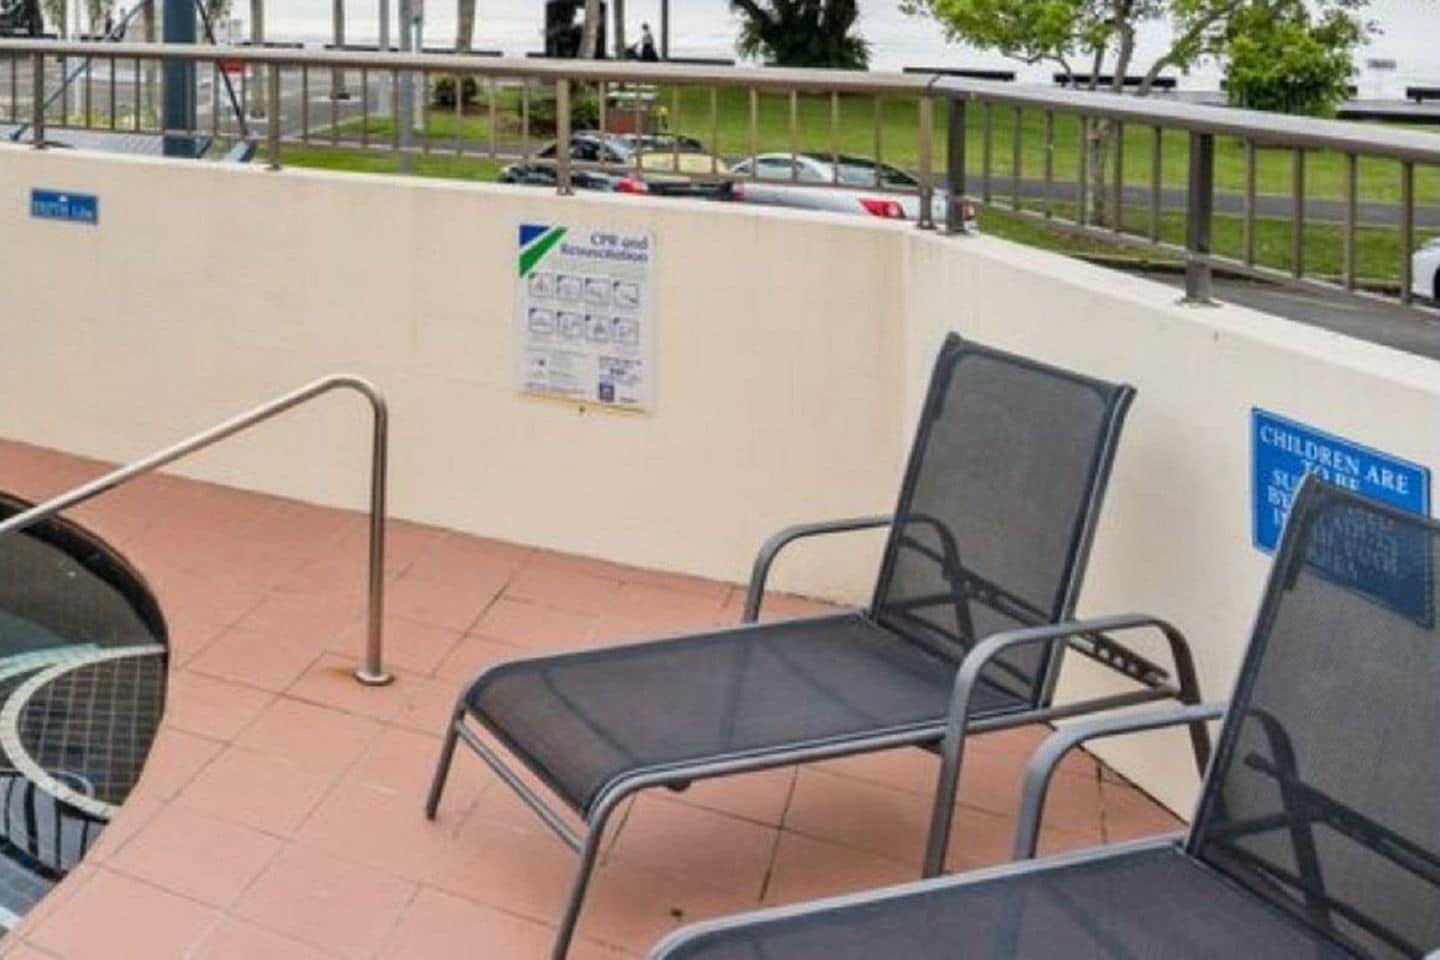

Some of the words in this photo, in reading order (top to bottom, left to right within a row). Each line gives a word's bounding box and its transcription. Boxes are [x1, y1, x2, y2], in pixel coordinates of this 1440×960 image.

[590, 233, 618, 246] CPR
[622, 236, 648, 250] and
[1260, 423, 1360, 476] CHILDREN
[1365, 463, 1409, 495] ARE
[1301, 458, 1330, 482] TO
